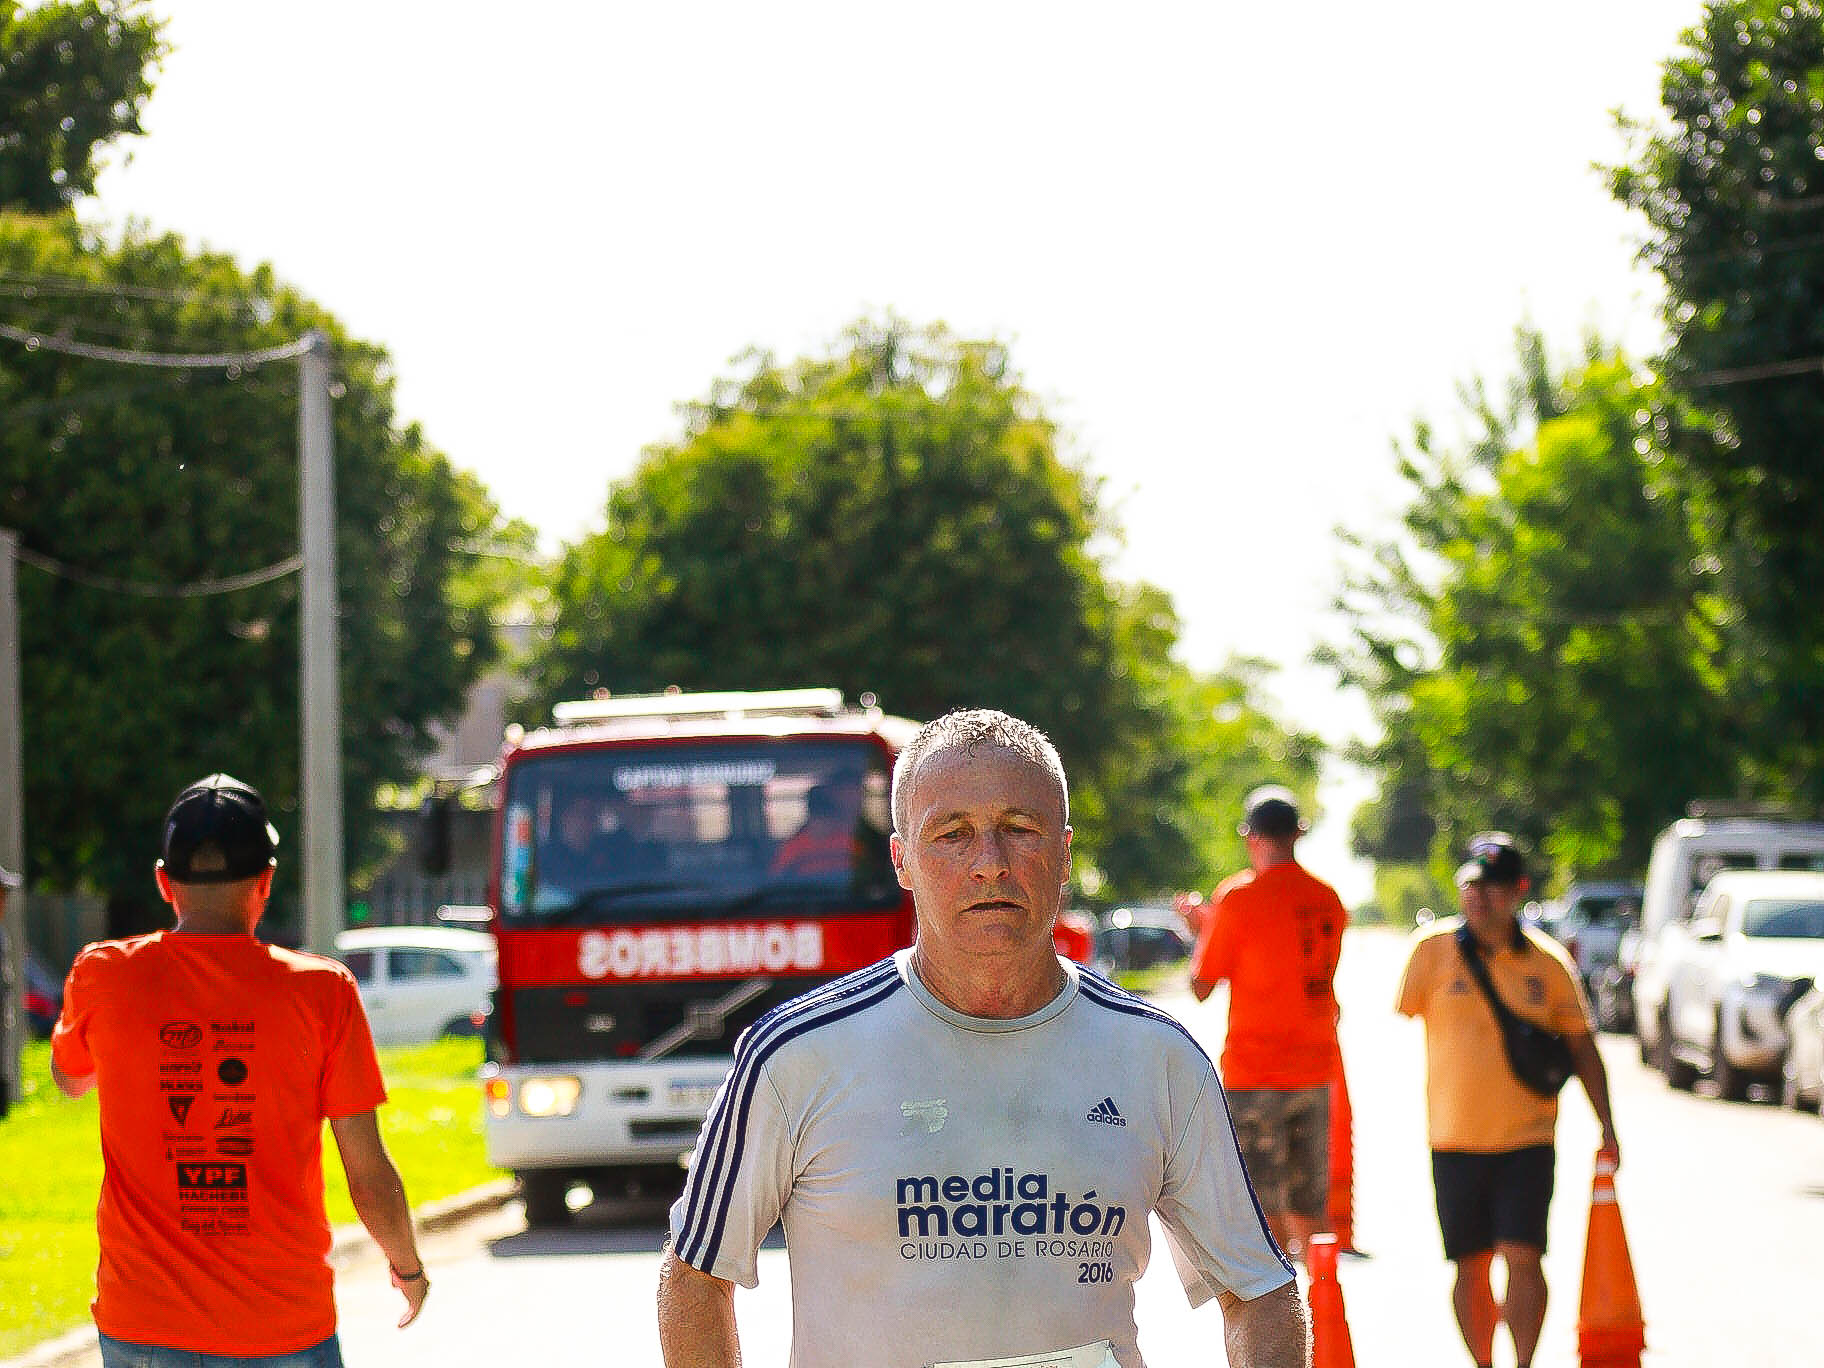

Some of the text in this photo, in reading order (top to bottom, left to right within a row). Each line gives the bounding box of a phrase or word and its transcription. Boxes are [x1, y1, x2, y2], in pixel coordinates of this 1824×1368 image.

[1087, 1111, 1127, 1127] adidas
[184, 1167, 241, 1185] YPF
[896, 1167, 1048, 1204] media
[897, 1190, 1126, 1237] maratón
[900, 1240, 1114, 1260] CIUDAD DE ROSARIO
[1078, 1263, 1114, 1283] 2016
